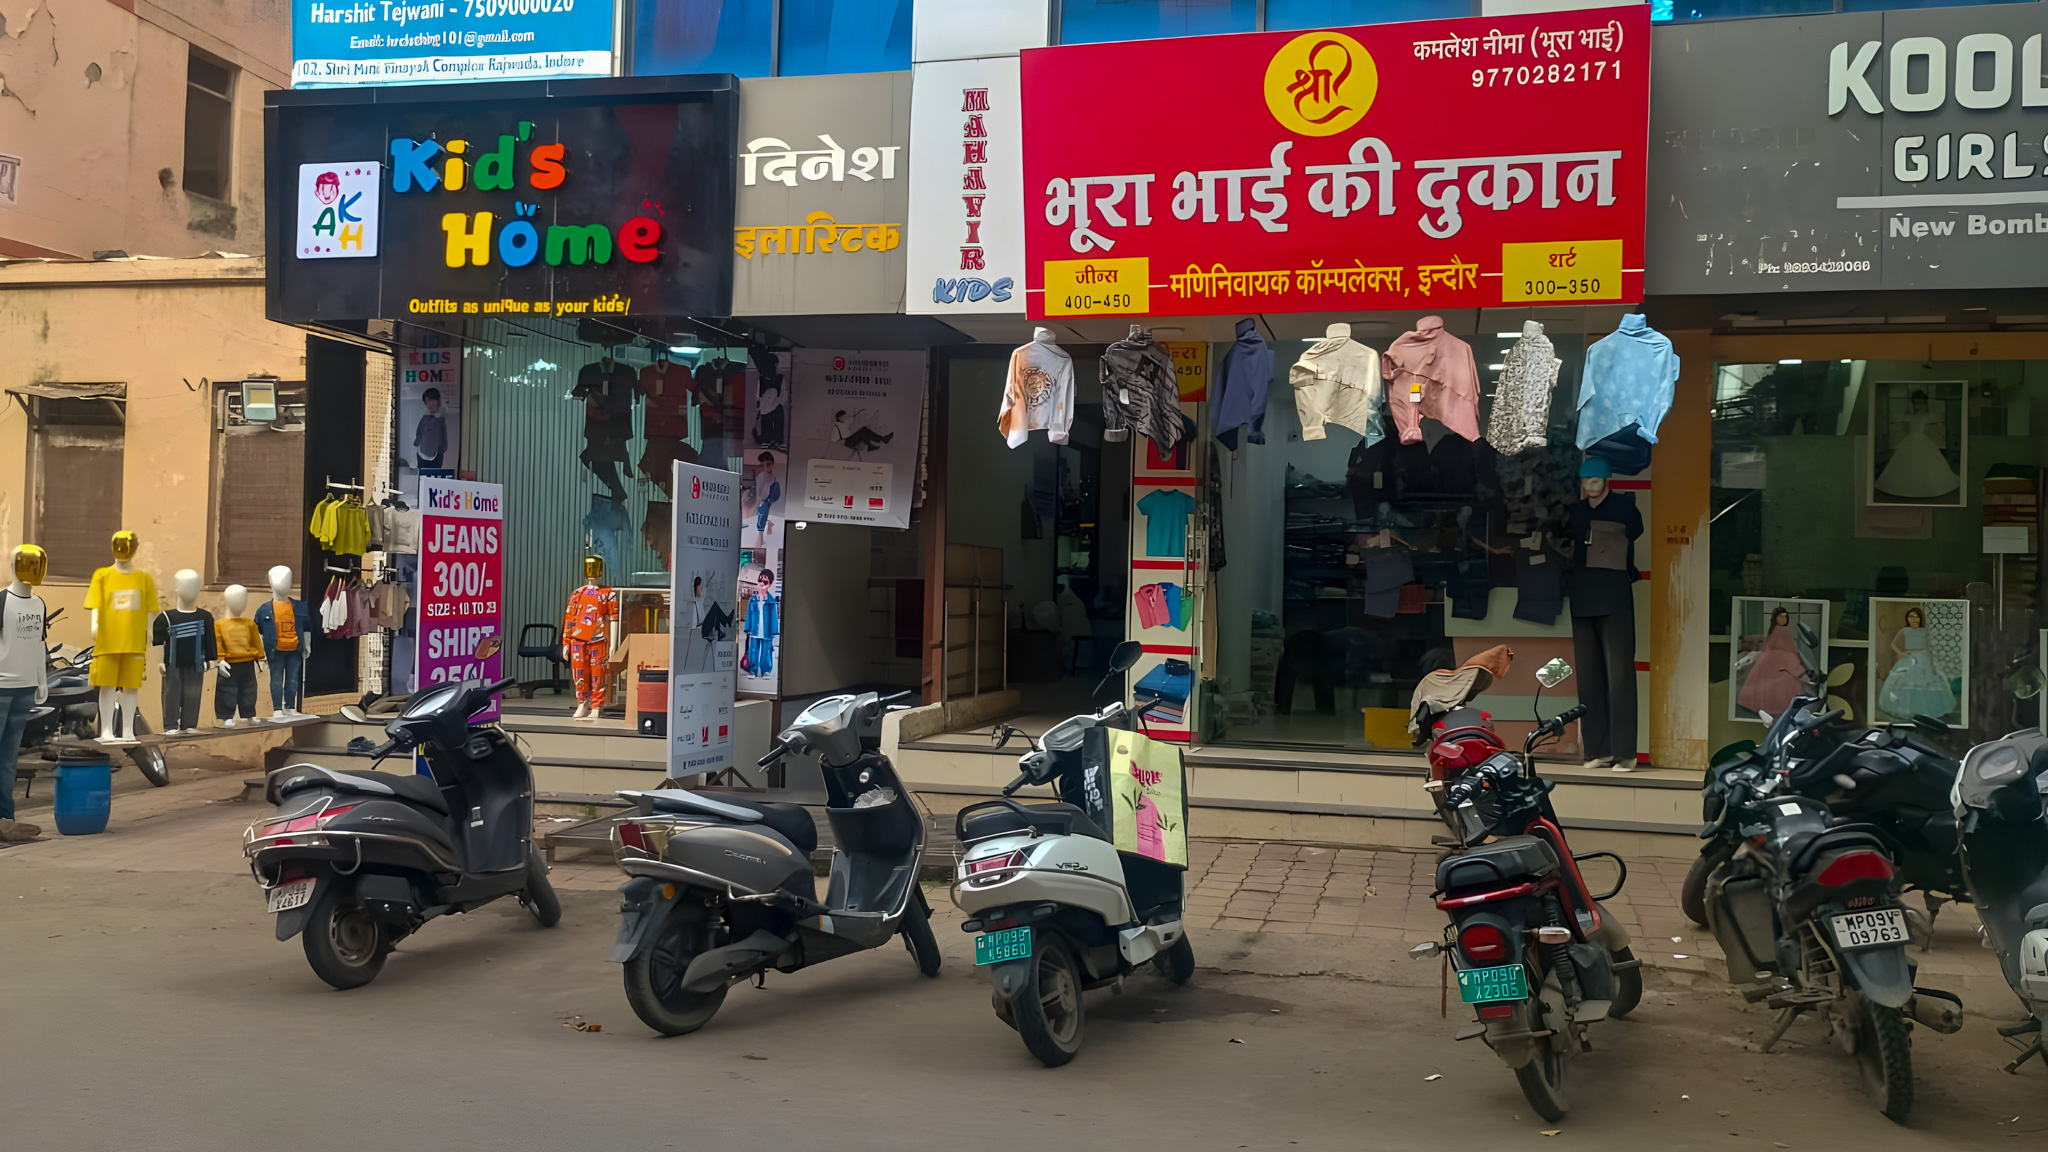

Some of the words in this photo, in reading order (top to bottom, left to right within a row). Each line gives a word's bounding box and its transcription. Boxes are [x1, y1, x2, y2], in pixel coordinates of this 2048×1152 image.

[311, 2, 376, 24] Harshit
[380, 0, 444, 27] Tejwani
[1413, 32, 1479, 61] कमलेश
[1482, 28, 1525, 56] नीमा
[1530, 26, 1574, 58] (भूरा
[1578, 20, 1624, 52] भाई)
[1286, 39, 1353, 124] श्री
[1472, 60, 1621, 87] 9770282171
[391, 120, 567, 194] Kid's
[739, 133, 901, 187] दिनेश
[1893, 131, 2048, 183] GIRL
[1045, 173, 1155, 253] भूरा
[1171, 140, 1294, 233] भाई
[1305, 136, 1401, 218] की
[1414, 149, 1623, 239] दुकान
[441, 204, 663, 268] Home
[734, 210, 901, 260] इलास्टिक
[1889, 216, 1956, 238] New
[1549, 246, 1577, 267] शर्ट
[1075, 264, 1119, 285] जीन्स
[1418, 254, 1479, 296] इन्दौर
[1525, 278, 1601, 295] 300-350
[932, 276, 1015, 304] KIDS
[1065, 293, 1131, 309] 400-450
[463, 302, 478, 313] as
[534, 301, 550, 313] as
[556, 301, 589, 316] your
[409, 351, 451, 365] KIDS
[429, 488, 460, 510] Kid's
[465, 491, 498, 512] Home
[428, 524, 498, 554] JEANS
[433, 561, 493, 597] 300/-
[427, 602, 450, 616] SIZE
[472, 602, 484, 614] TO
[1844, 911, 1894, 930] MP09V
